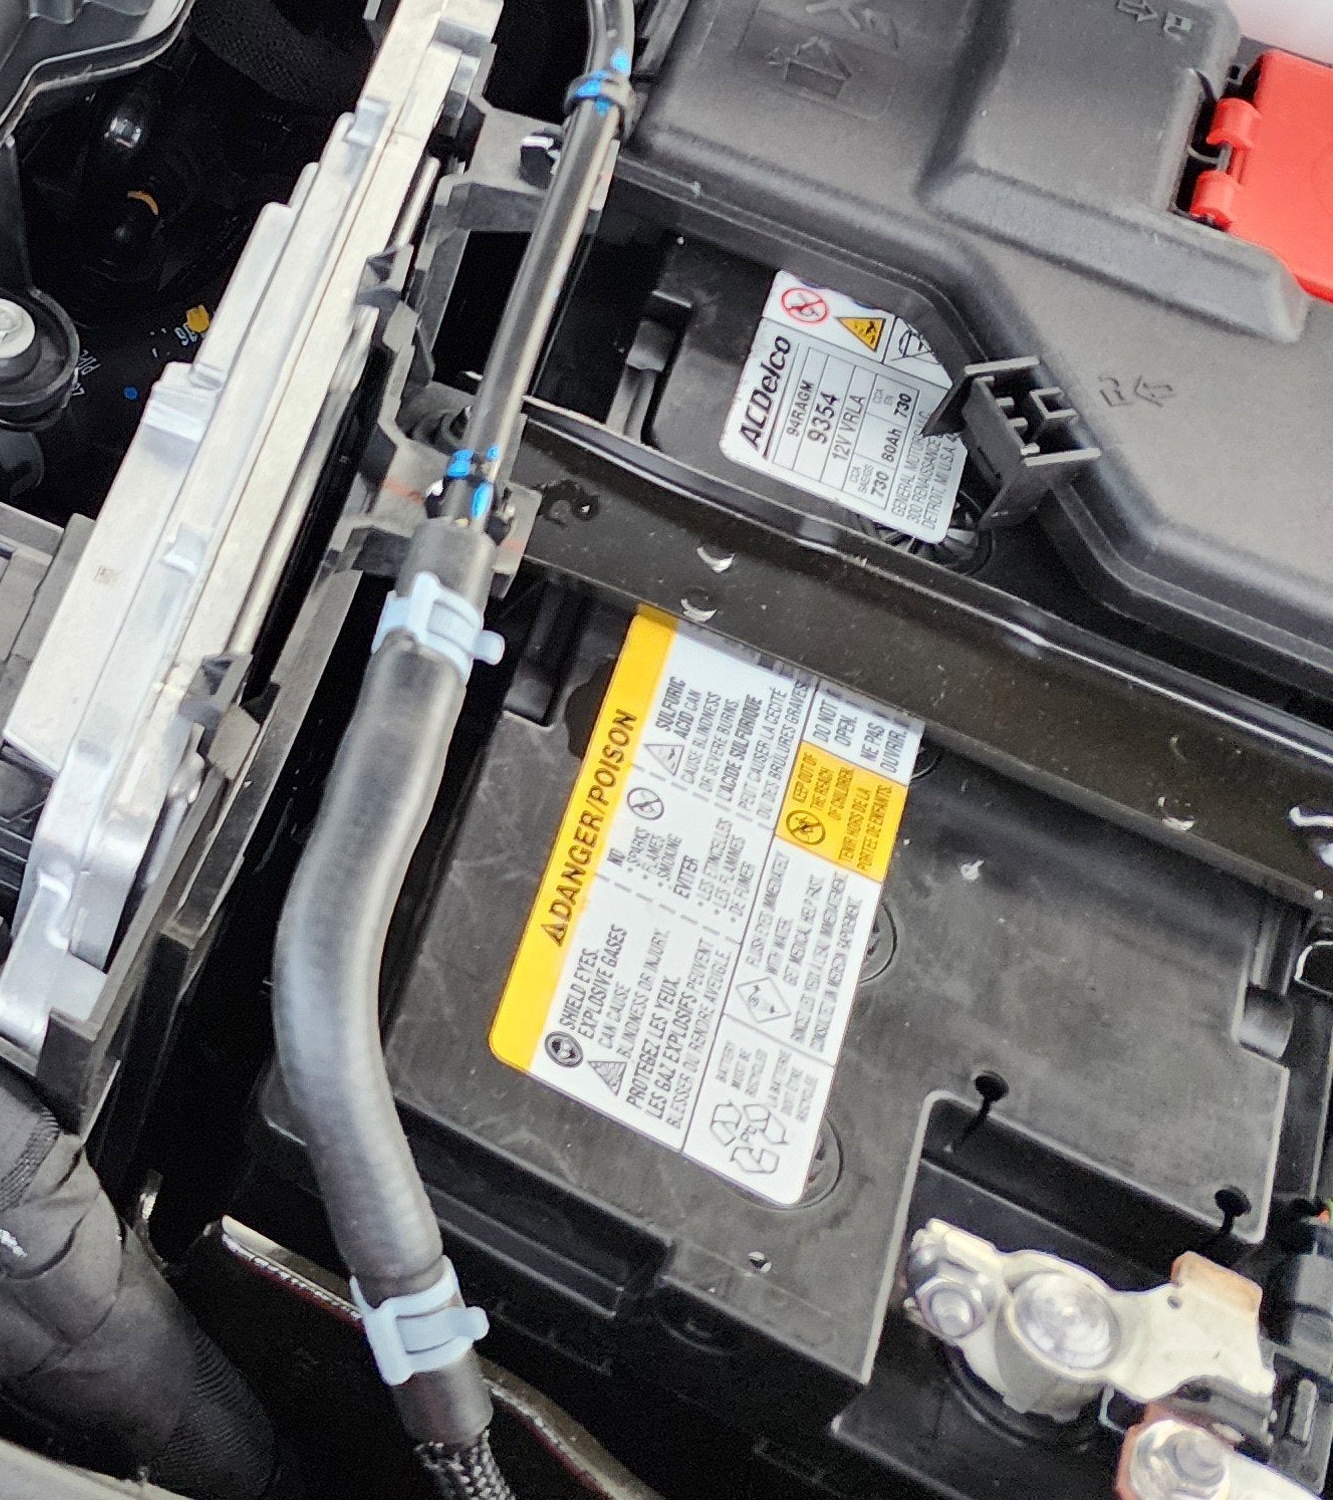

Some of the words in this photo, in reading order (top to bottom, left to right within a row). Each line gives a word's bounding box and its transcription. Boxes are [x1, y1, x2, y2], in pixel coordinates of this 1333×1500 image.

[740, 336, 790, 446] ACDelco
[786, 379, 814, 435] 94RAGM
[893, 392, 912, 417] 730
[807, 391, 838, 443] 9354
[840, 394, 865, 431] VRLA
[831, 433, 852, 460] 12V
[881, 428, 901, 462] 80Ah
[870, 470, 889, 497] 730
[911, 436, 940, 501] RENAISSANCE
[891, 474, 915, 516] GENERAL
[906, 503, 923, 524] 300
[655, 676, 685, 731] SULFURIC
[683, 688, 701, 711] CAN
[817, 698, 837, 725] NOT
[673, 710, 694, 739] ACID
[691, 691, 721, 748] BLINDNESS
[703, 735, 727, 775] SEVERE
[716, 698, 739, 735] BURNS.
[729, 694, 761, 760] SULFURIQUE
[812, 723, 831, 743] DO
[833, 714, 857, 746] OPEN.
[864, 721, 885, 743] PAS
[680, 750, 703, 784] CAUSE
[738, 781, 756, 811] PEUT
[747, 739, 769, 782] CAUSER
[760, 725, 775, 740] LA
[802, 751, 817, 766] OF
[859, 743, 879, 761] NE
[879, 729, 906, 773] OUVRIR.
[797, 763, 813, 783] OUT
[761, 779, 779, 803] DES
[791, 780, 808, 803] KEEP
[851, 798, 867, 813] DE
[856, 786, 870, 801] LA
[550, 710, 635, 919] DANGER/POISON
[846, 811, 864, 835] HORS
[865, 822, 881, 838] DE
[626, 826, 650, 866] SPARKS
[641, 834, 665, 871] FLAMES
[656, 834, 681, 881] SMOKING
[718, 835, 745, 883] FLAMMES
[673, 854, 697, 898] EVITER
[697, 878, 714, 901] LES
[733, 861, 754, 897] FUMER
[712, 886, 730, 909] LES
[728, 899, 745, 917] DE
[643, 930, 665, 972] INJURY.
[685, 937, 711, 990] PEUVENT
[559, 983, 586, 1030] SHIELD
[573, 947, 598, 983] EYES.
[577, 967, 613, 1039] EXPLOSIVE
[600, 924, 627, 967] GASES
[636, 972, 652, 991] OR
[654, 976, 680, 1010] YEUX.
[605, 981, 630, 1022] CAUSE
[597, 1024, 616, 1049] CAN
[616, 991, 648, 1058] BLINDNESS
[648, 1012, 668, 1039] LES
[662, 991, 696, 1063] EXPLOSIFS
[666, 1072, 692, 1129] BLESSER
[688, 1004, 714, 1050] RENDRE
[703, 950, 730, 1003] AVEUGLE.
[625, 1038, 660, 1107] PROTEGEZ
[653, 1062, 676, 1092] GAZ
[646, 1091, 667, 1119] LES
